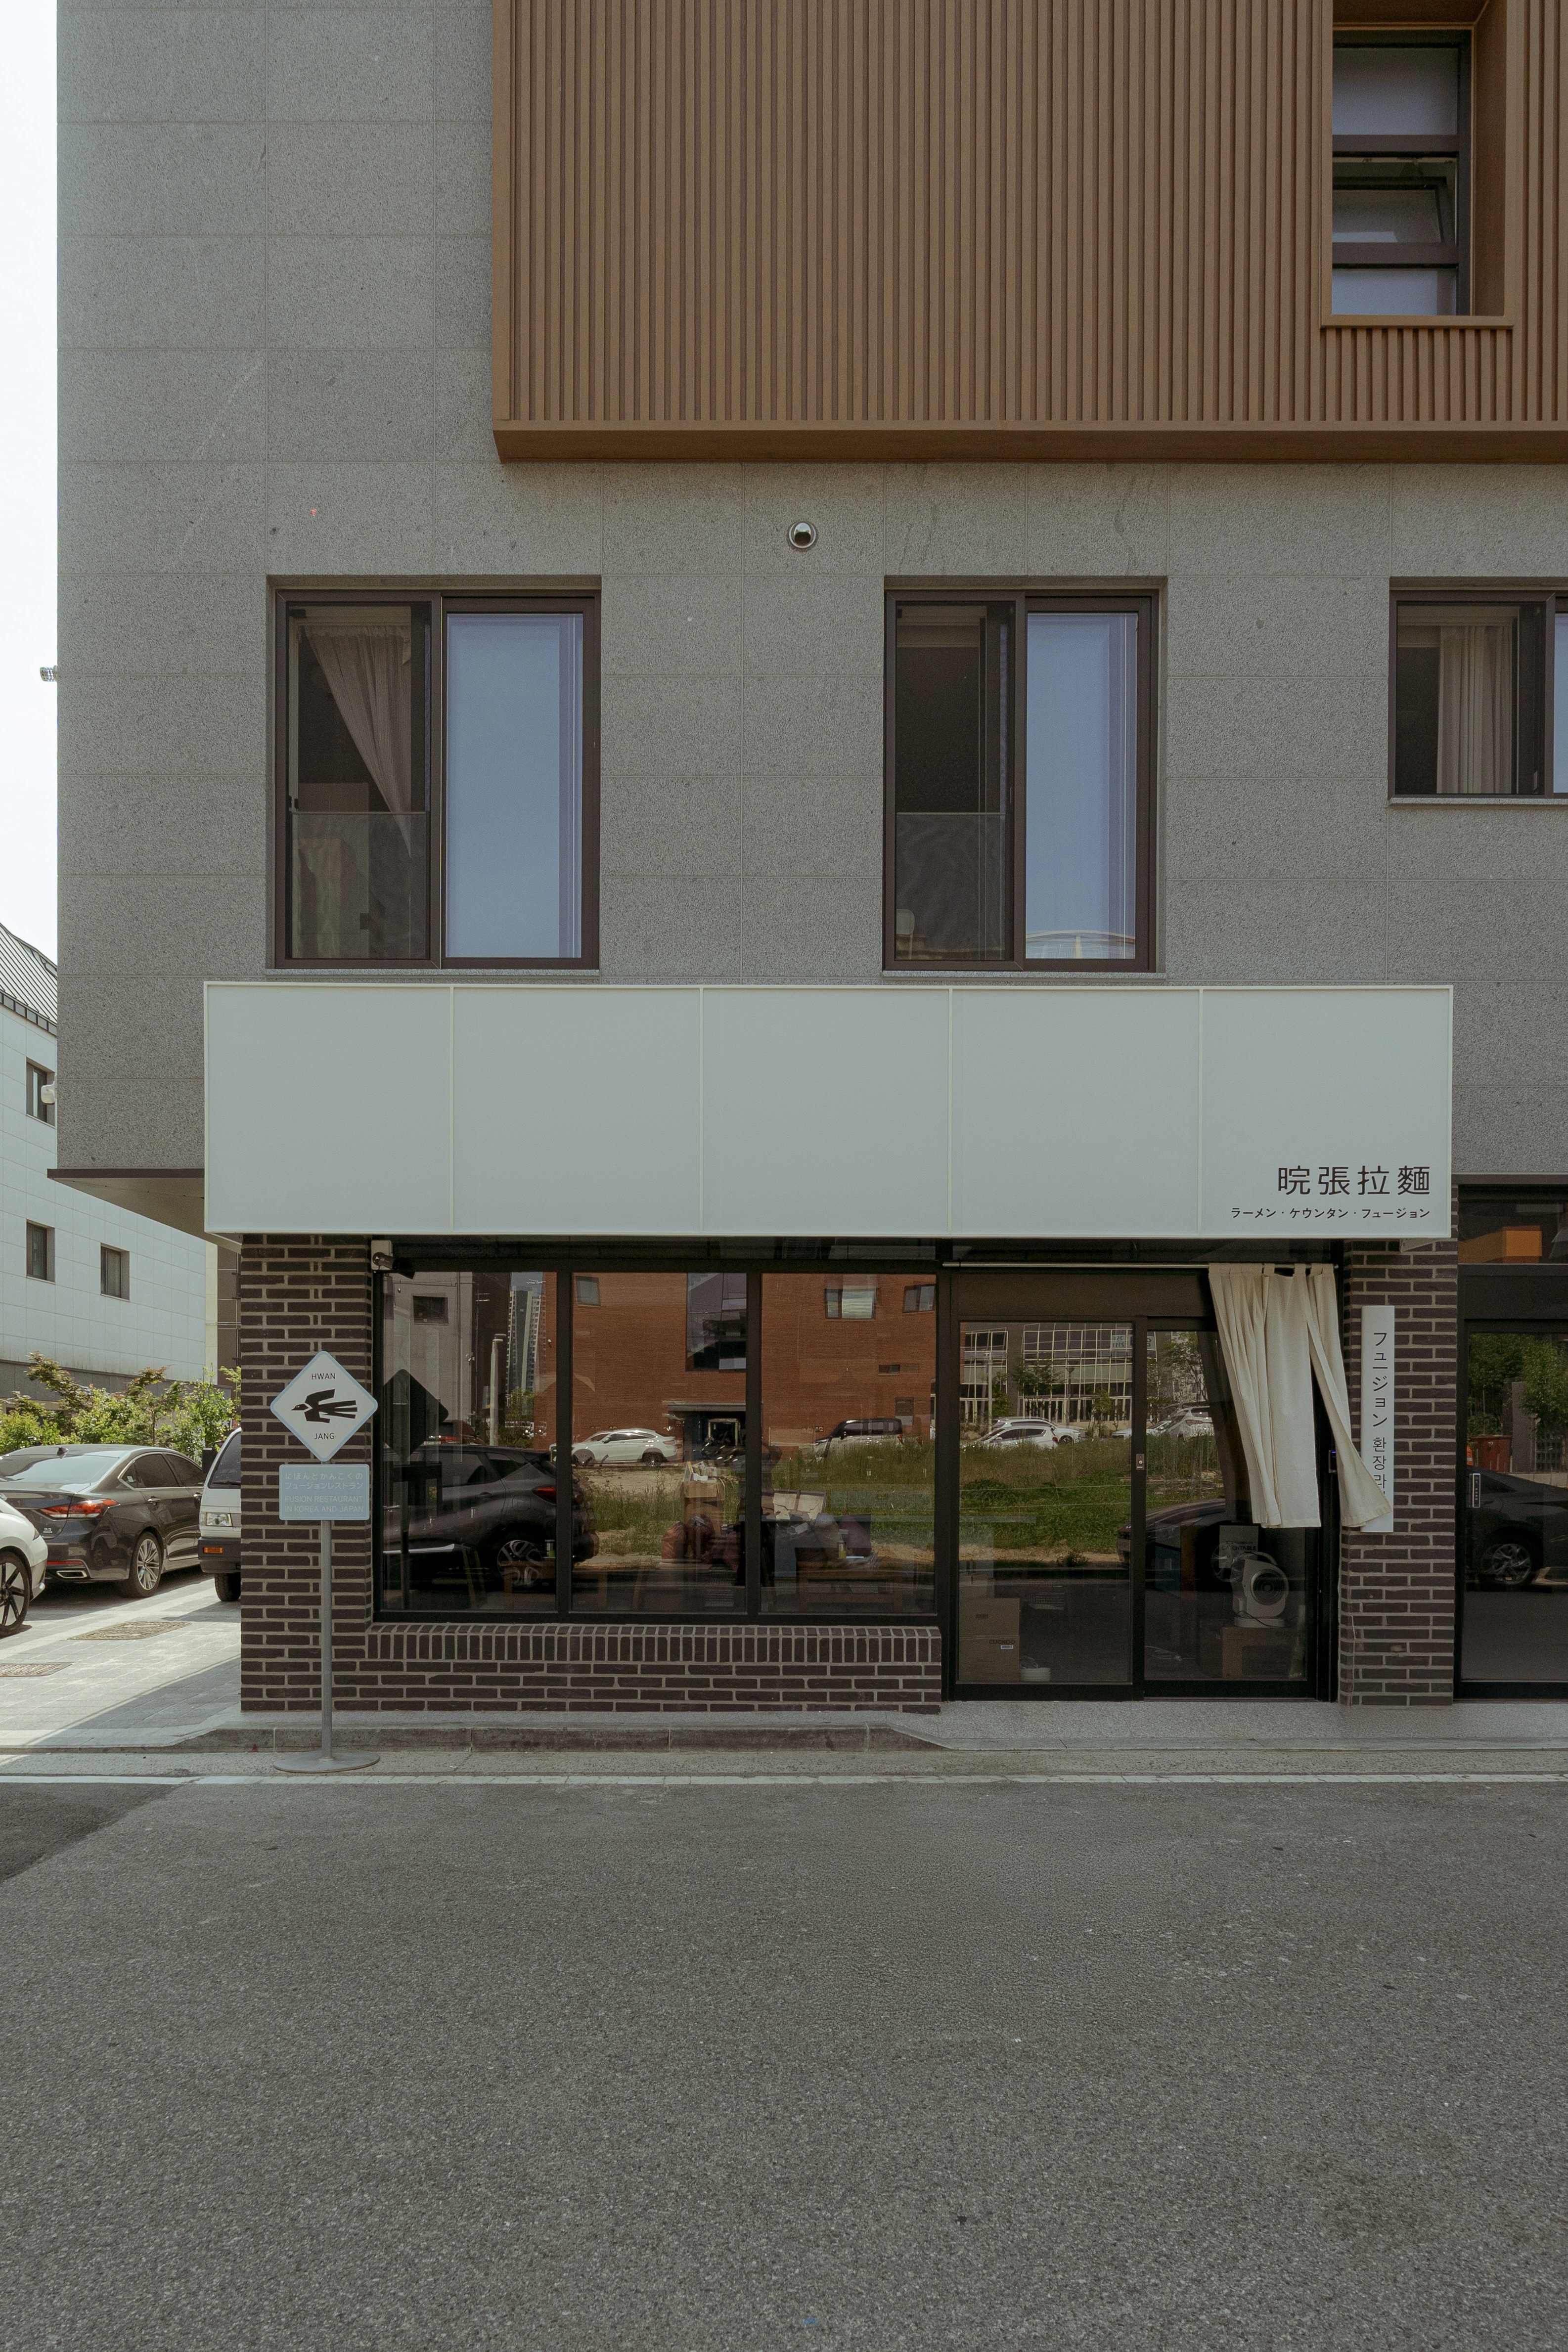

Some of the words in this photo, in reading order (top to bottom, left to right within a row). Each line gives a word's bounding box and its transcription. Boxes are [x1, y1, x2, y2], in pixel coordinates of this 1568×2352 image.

[1278, 1165, 1430, 1196] 晥張拉麵
[1372, 1332, 1388, 1427] フュージョン
[285, 1472, 363, 1480] にほんとかんこくの
[1372, 1436, 1388, 1494] 환장라
